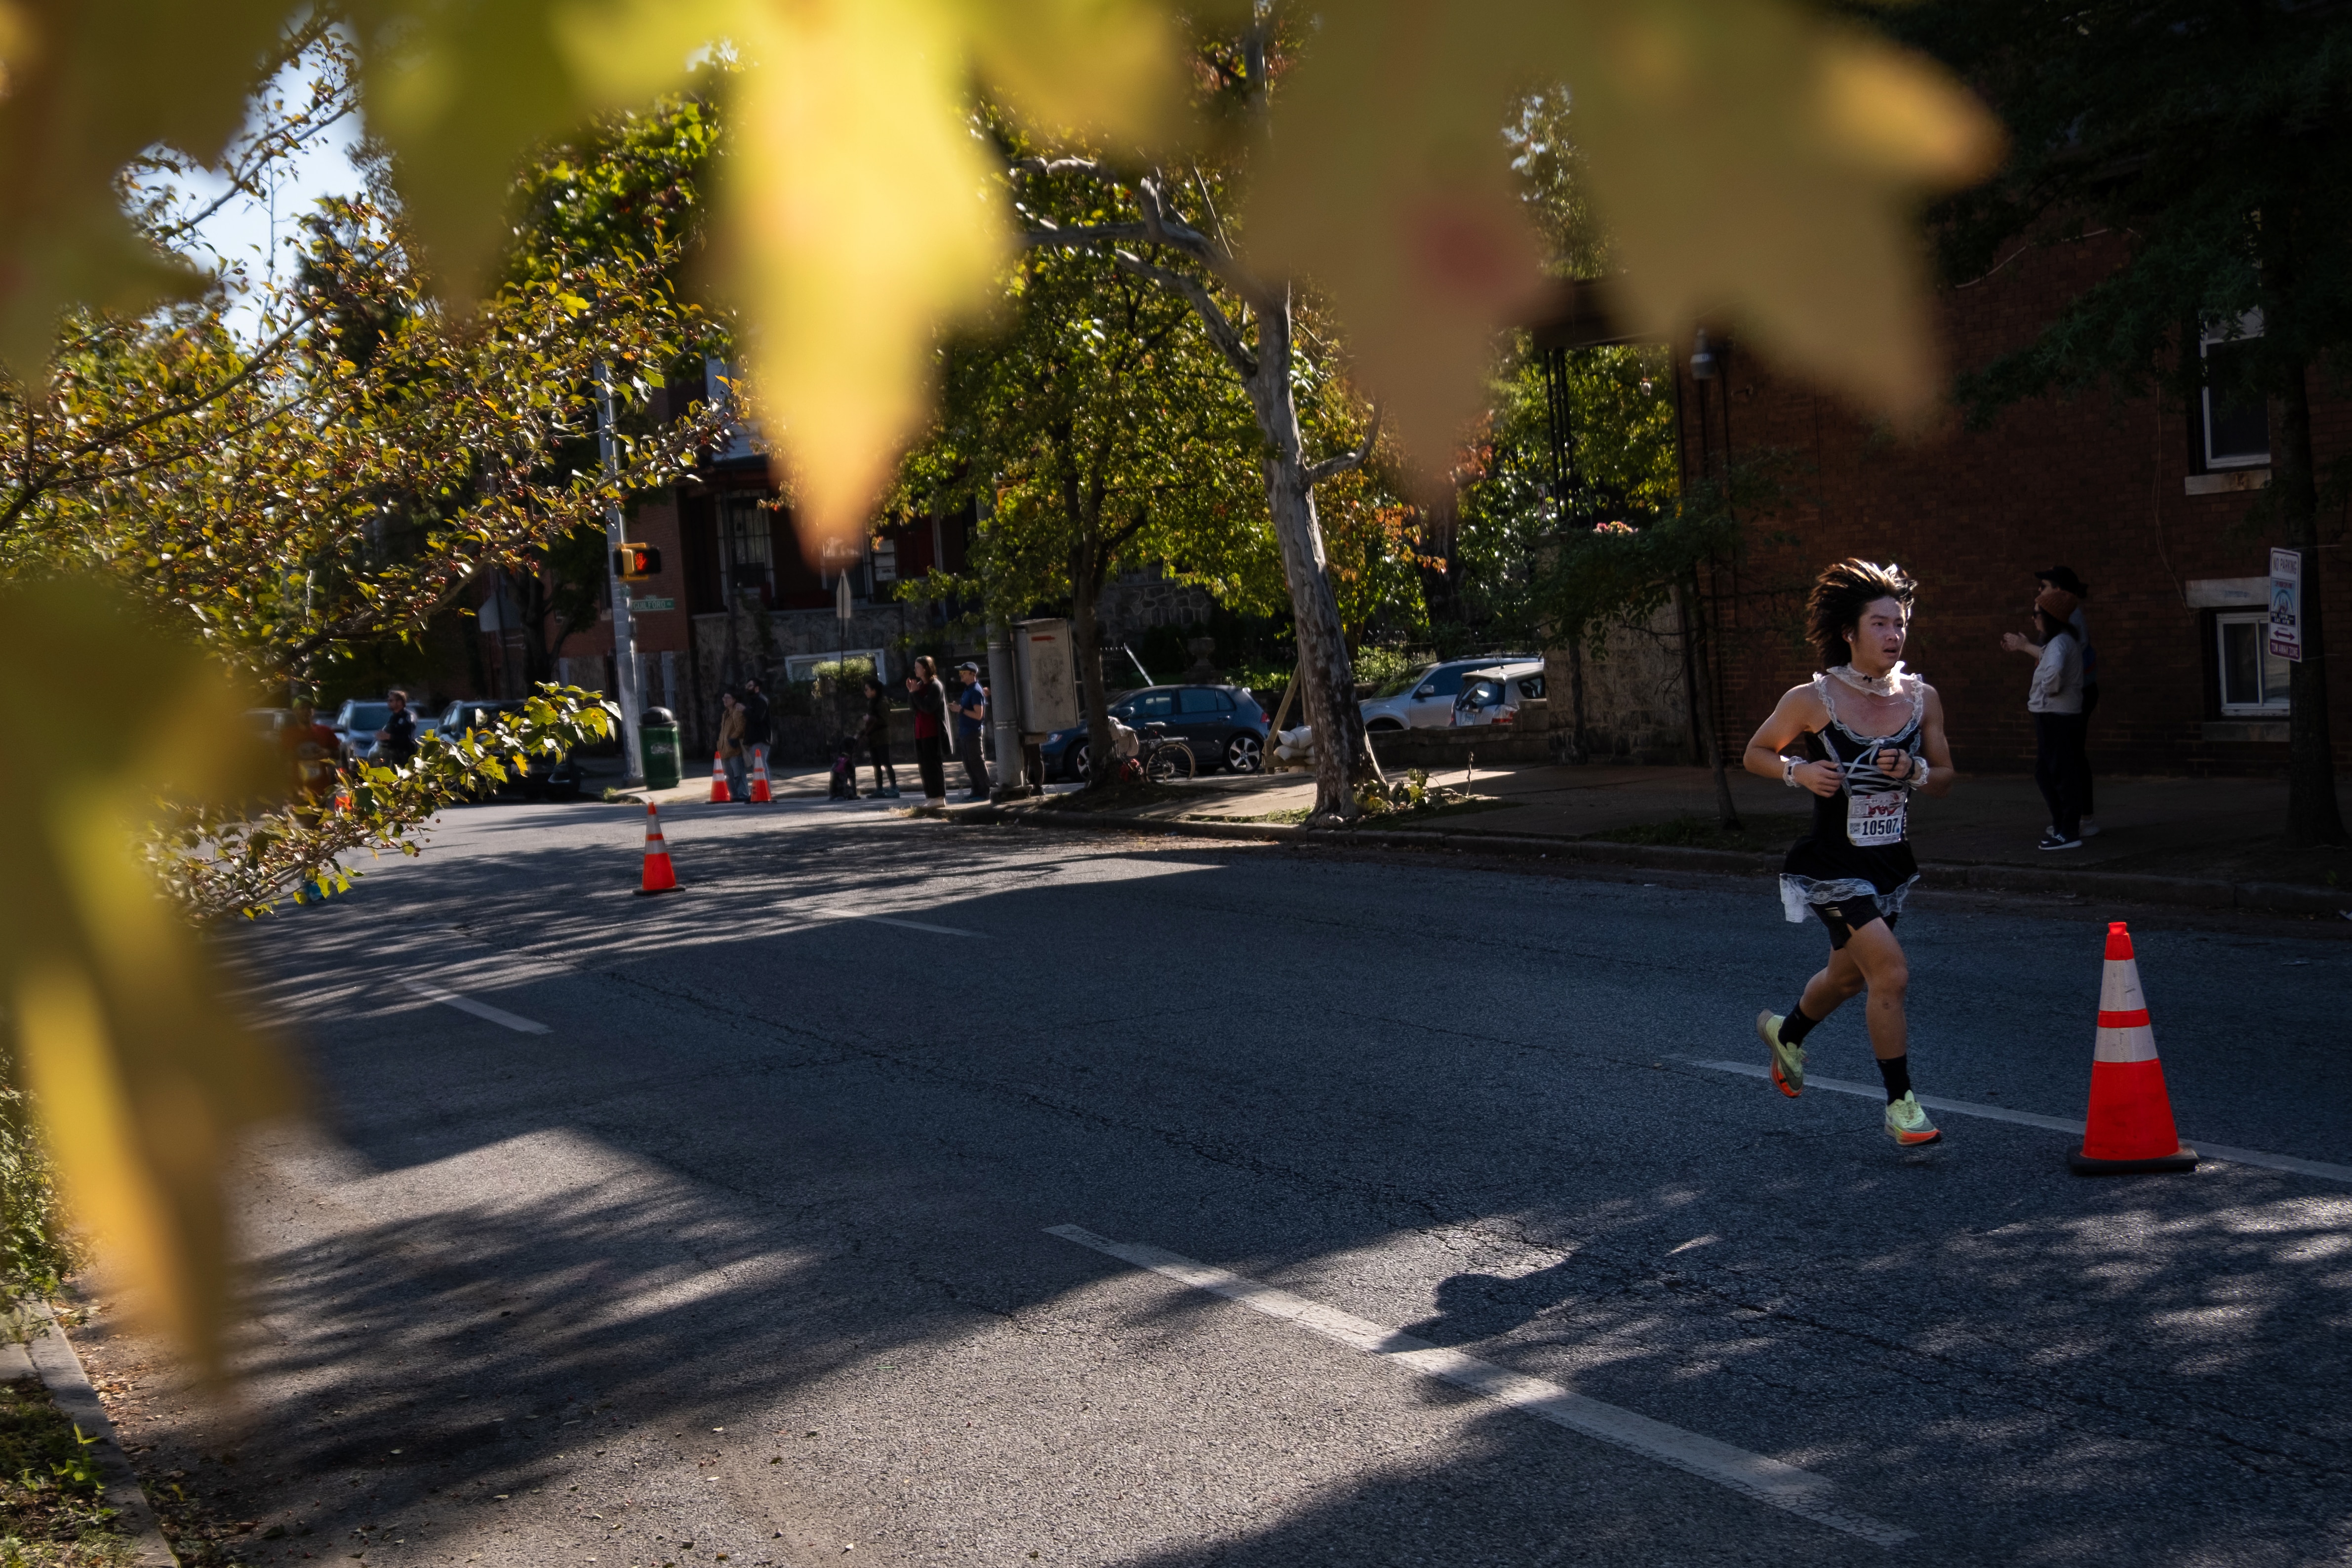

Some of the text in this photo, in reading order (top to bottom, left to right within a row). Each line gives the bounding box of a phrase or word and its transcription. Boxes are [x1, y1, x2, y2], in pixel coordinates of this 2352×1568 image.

[2273, 557, 2297, 575] NO PARKING
[633, 601, 666, 609] GUILFORD
[1852, 805, 1869, 815] 13.1
[1862, 818, 1898, 836] 10507
